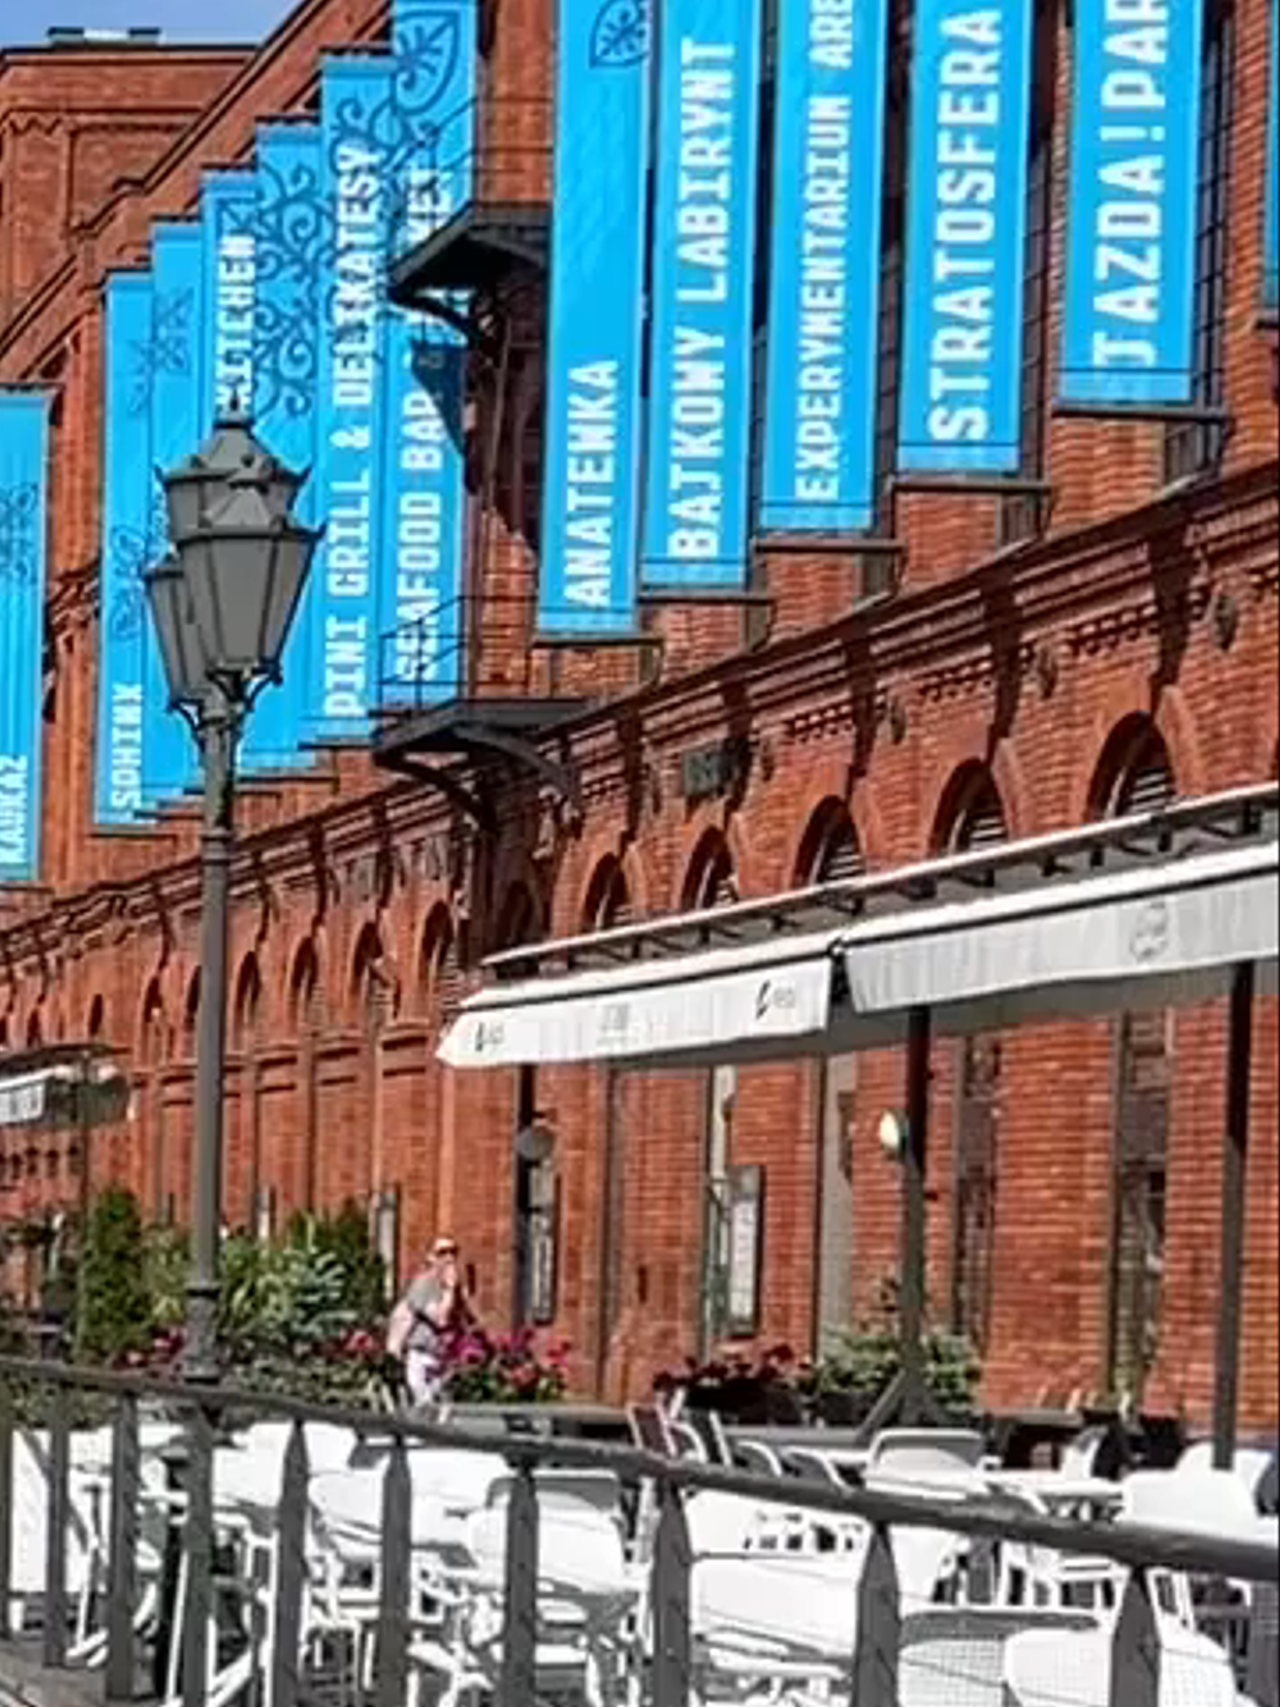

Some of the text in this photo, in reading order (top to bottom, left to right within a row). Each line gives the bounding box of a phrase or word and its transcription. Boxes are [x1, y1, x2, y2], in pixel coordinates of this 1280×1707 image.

[325, 145, 381, 719] PINI GRILL & DELIKATESY
[667, 37, 736, 559] BAJKOWY LABIRYNT
[795, 95, 851, 502] EXPERYMENTARIUM
[927, 8, 1002, 442] STRATOSFERA
[395, 492, 441, 683] SEAFOOD
[563, 359, 619, 609] ANATEWKA
